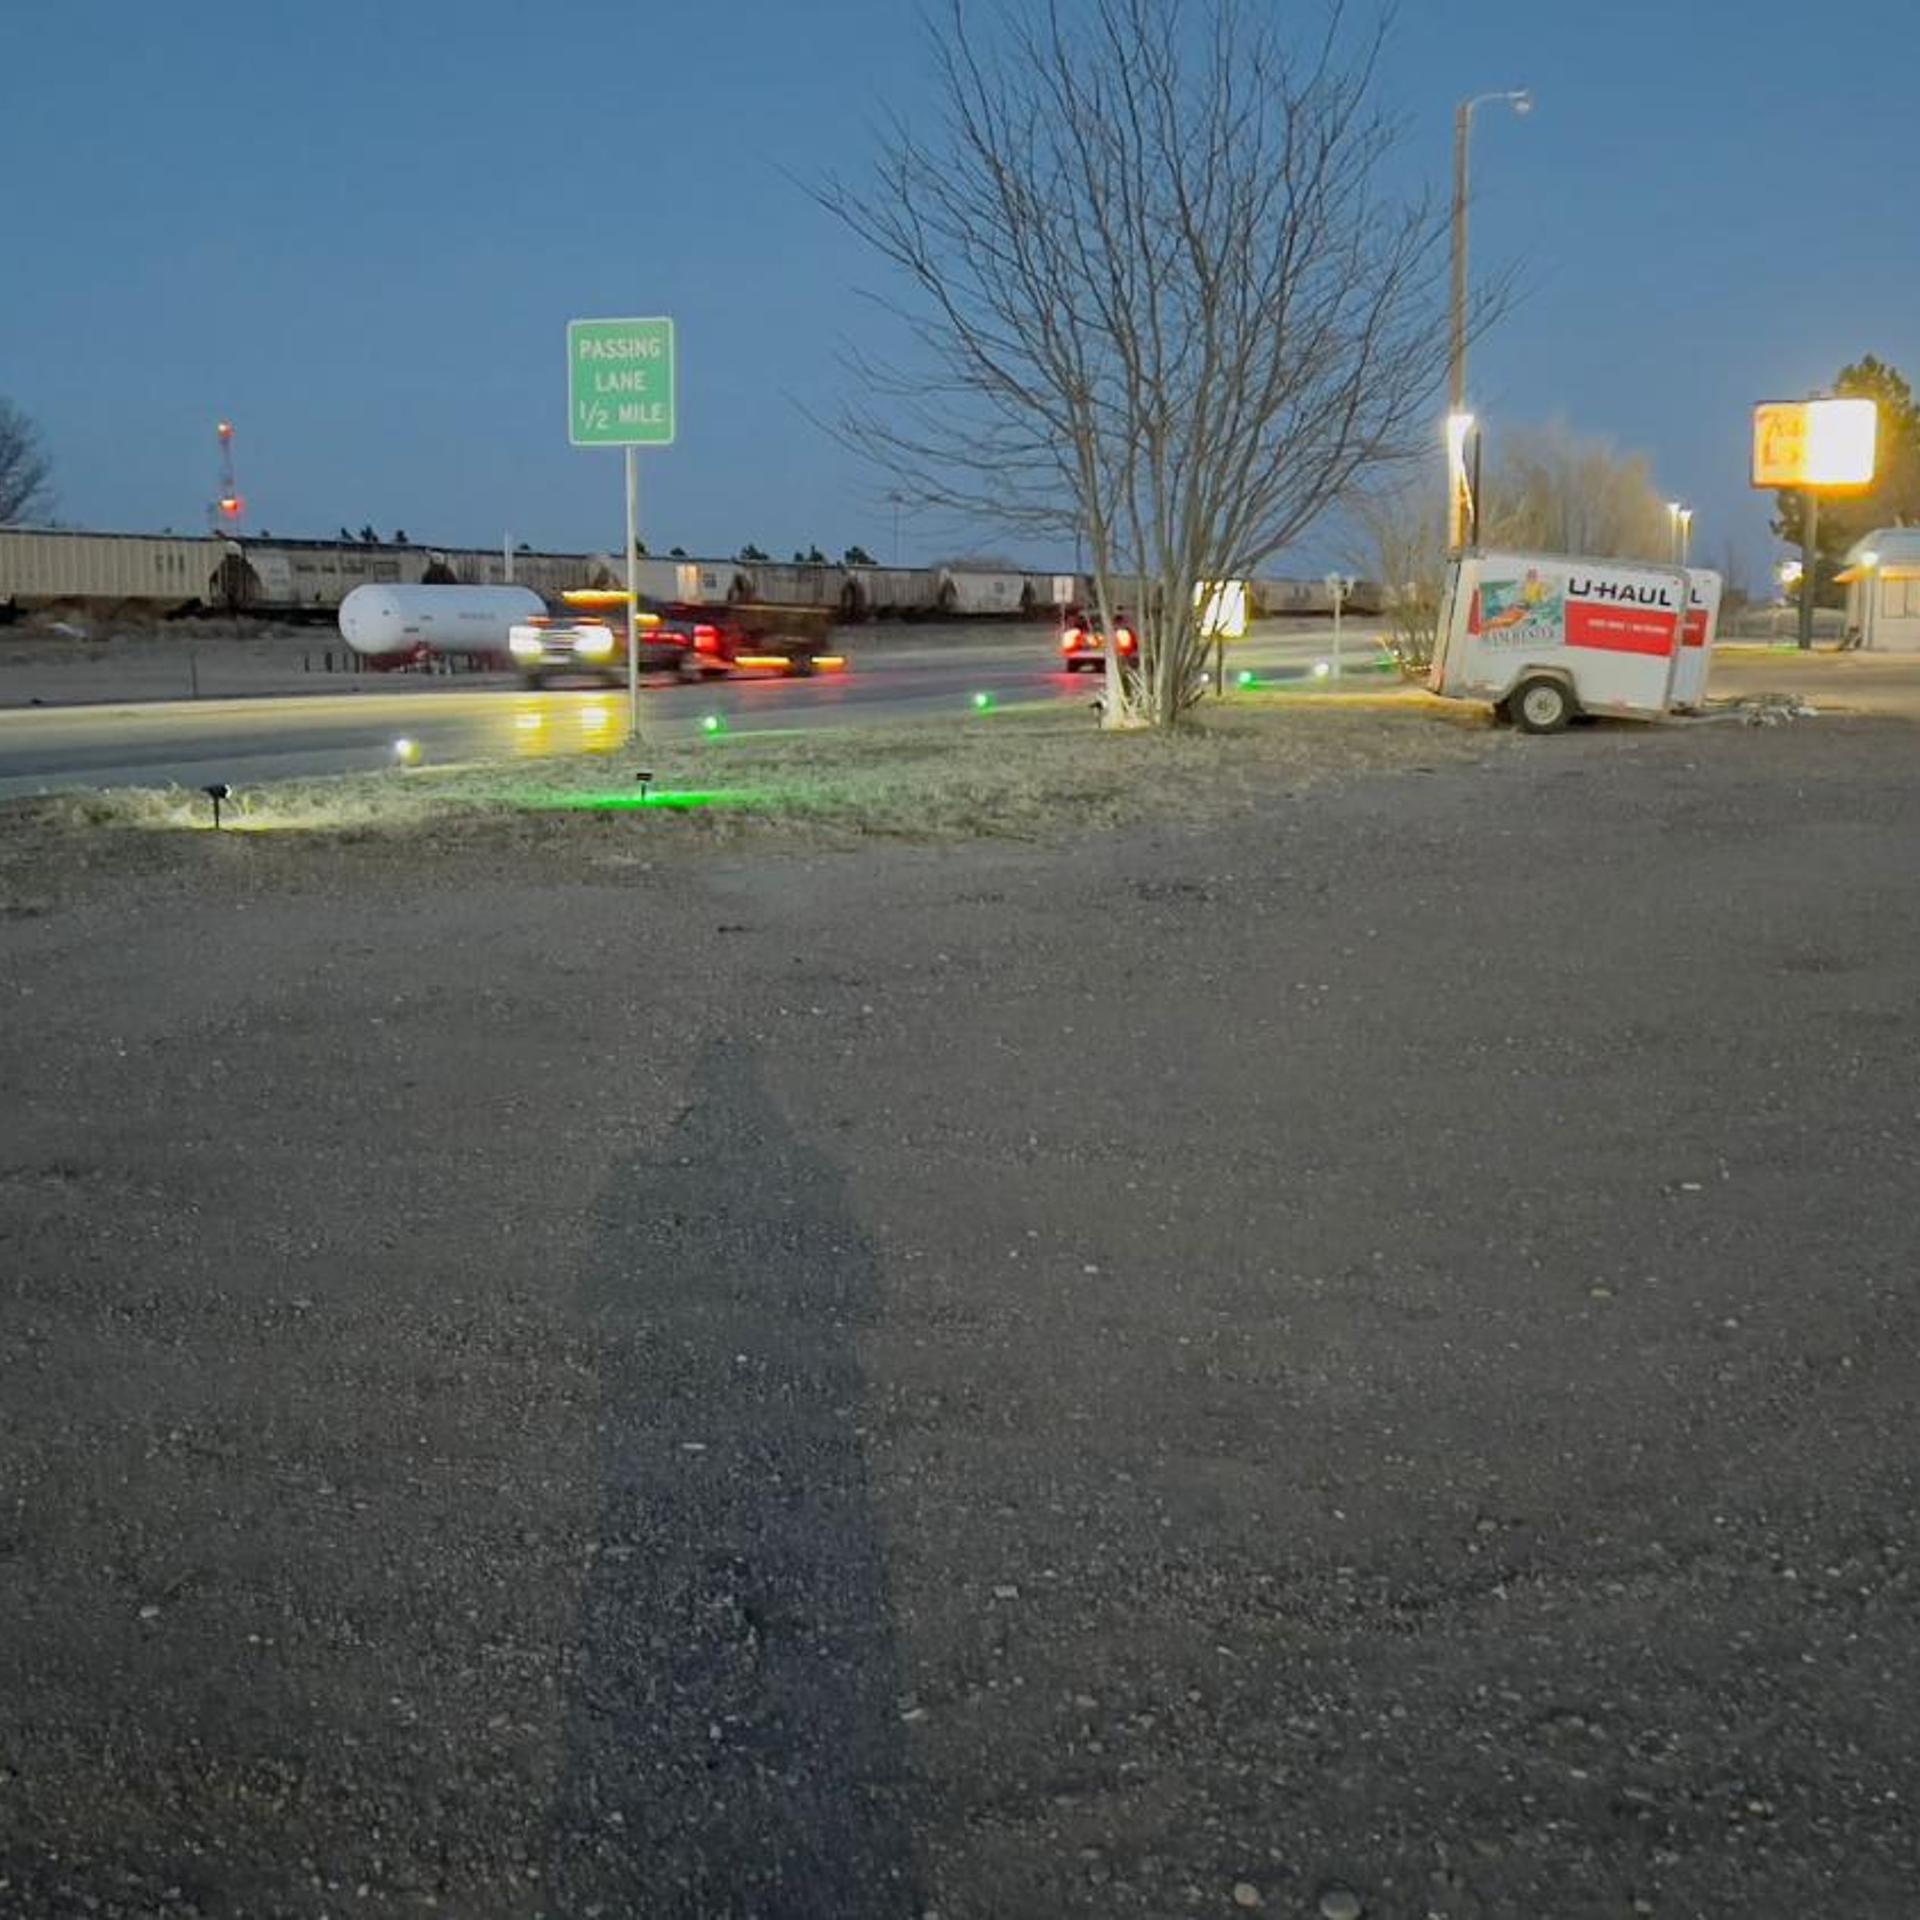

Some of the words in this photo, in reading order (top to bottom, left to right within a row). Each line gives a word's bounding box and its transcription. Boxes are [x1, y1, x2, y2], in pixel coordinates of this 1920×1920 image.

[579, 338, 661, 359] PASSING
[595, 369, 646, 392] LANE
[579, 400, 609, 430] 1/2
[618, 402, 664, 422] MILE
[1568, 577, 1672, 607] U-HAUL
